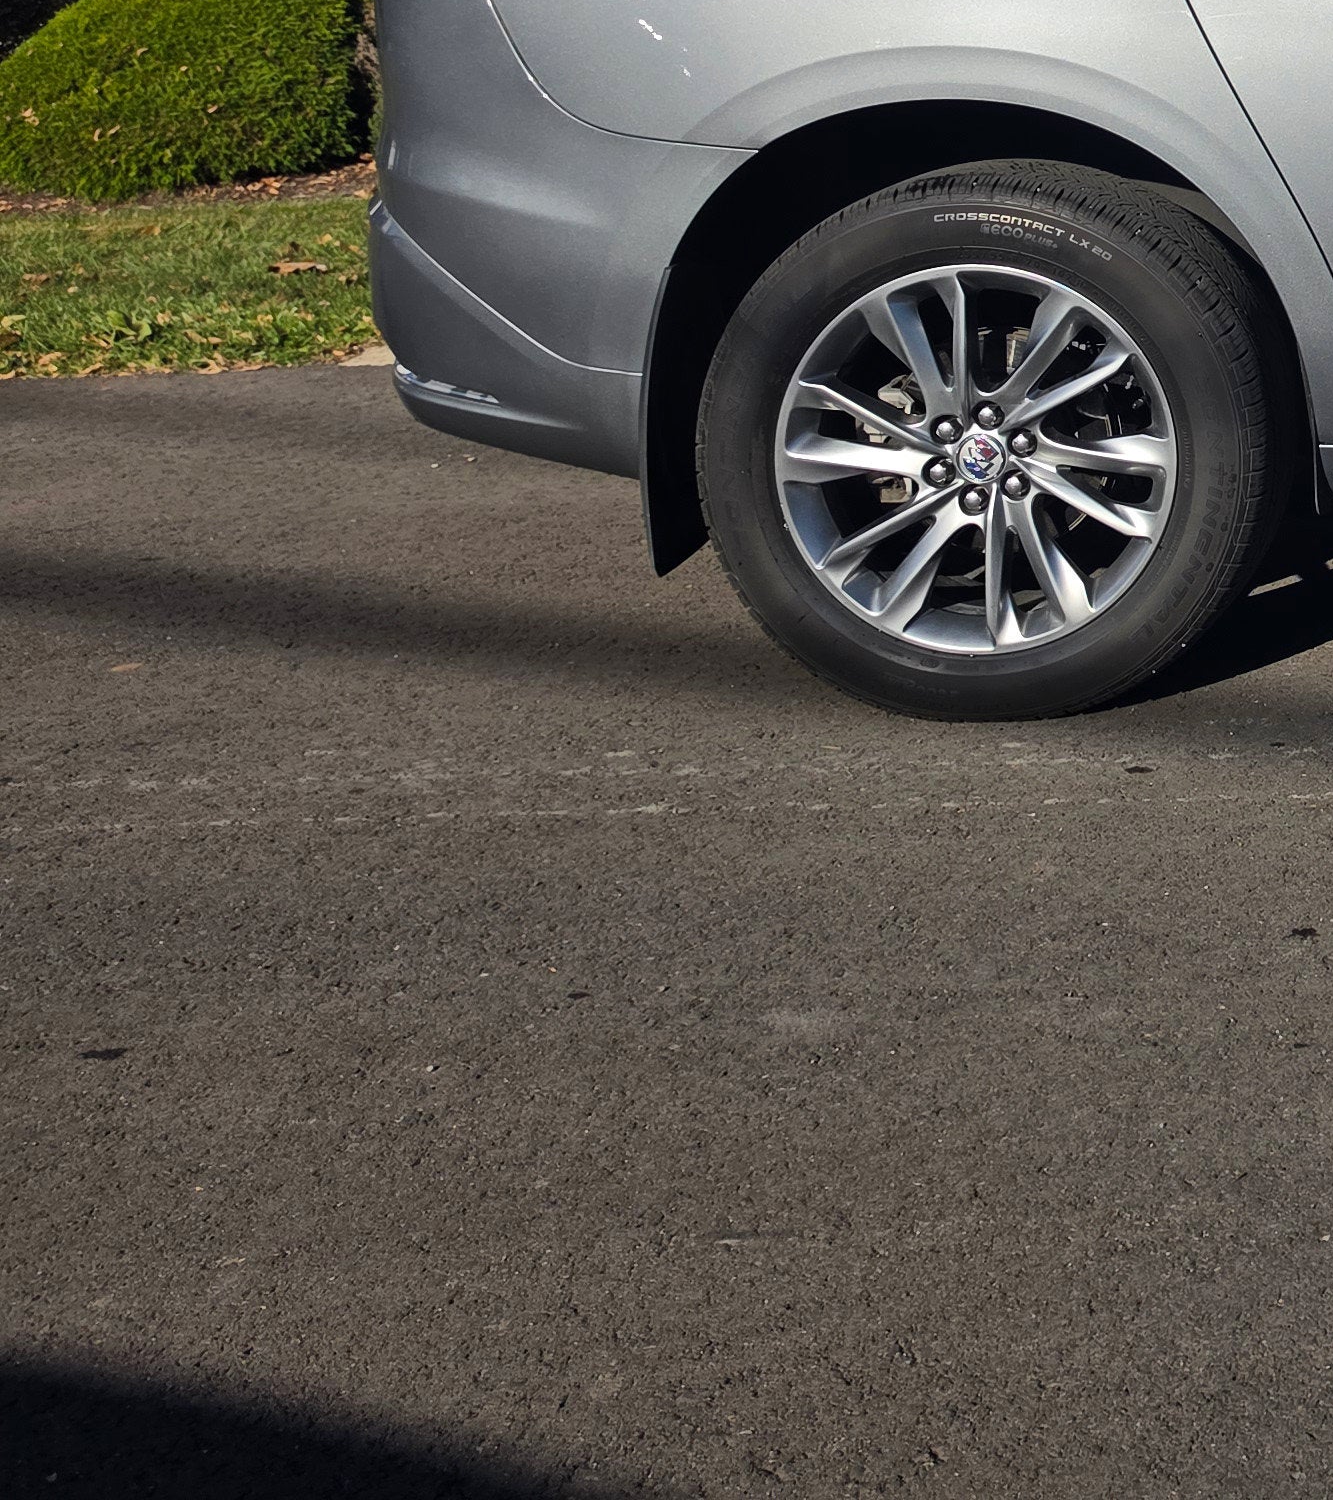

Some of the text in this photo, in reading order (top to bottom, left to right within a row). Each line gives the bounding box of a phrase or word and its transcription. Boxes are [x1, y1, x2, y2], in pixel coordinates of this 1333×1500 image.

[933, 212, 1113, 262] CROSSCONTACT LX 20
